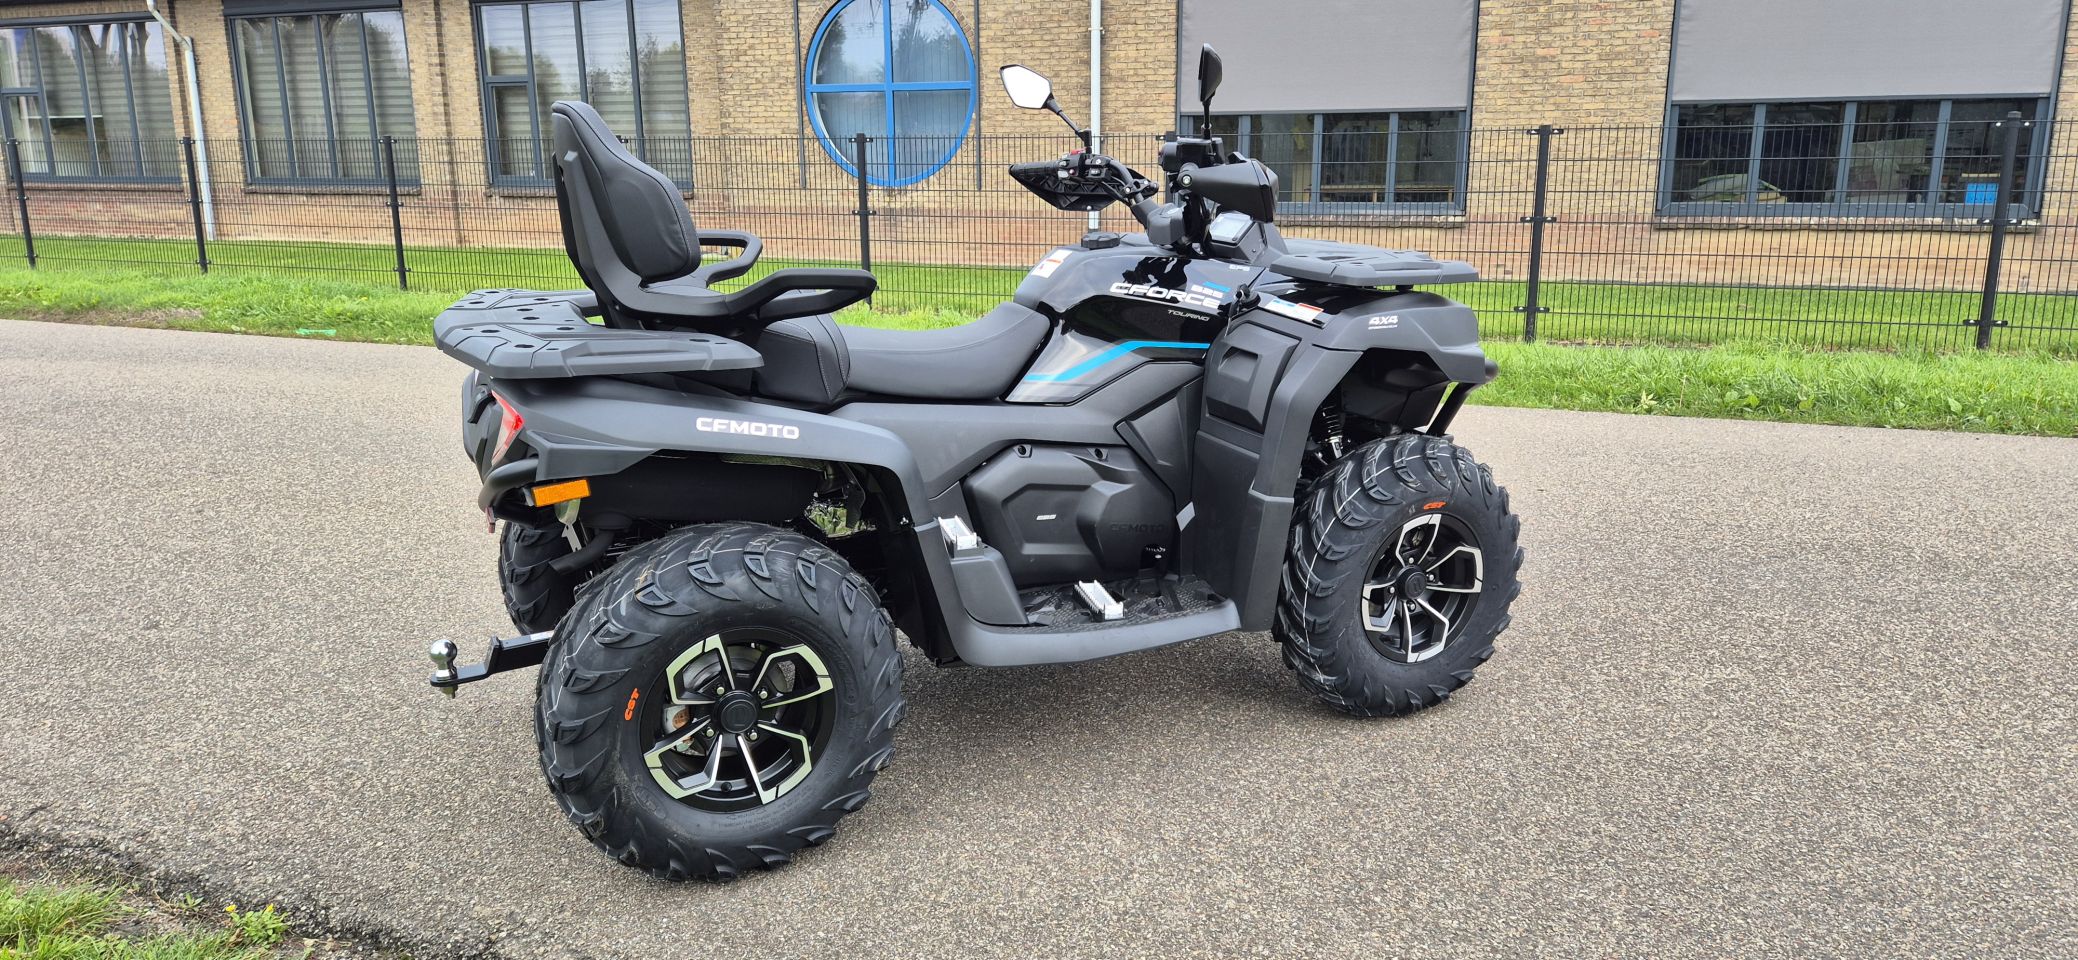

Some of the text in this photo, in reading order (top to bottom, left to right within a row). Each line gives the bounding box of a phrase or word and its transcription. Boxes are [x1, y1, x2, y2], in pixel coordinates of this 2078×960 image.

[1109, 282, 1221, 309] CFORCE
[1167, 309, 1210, 321] TOURING
[696, 417, 800, 440] CFMOTO
[624, 687, 640, 721] CST
